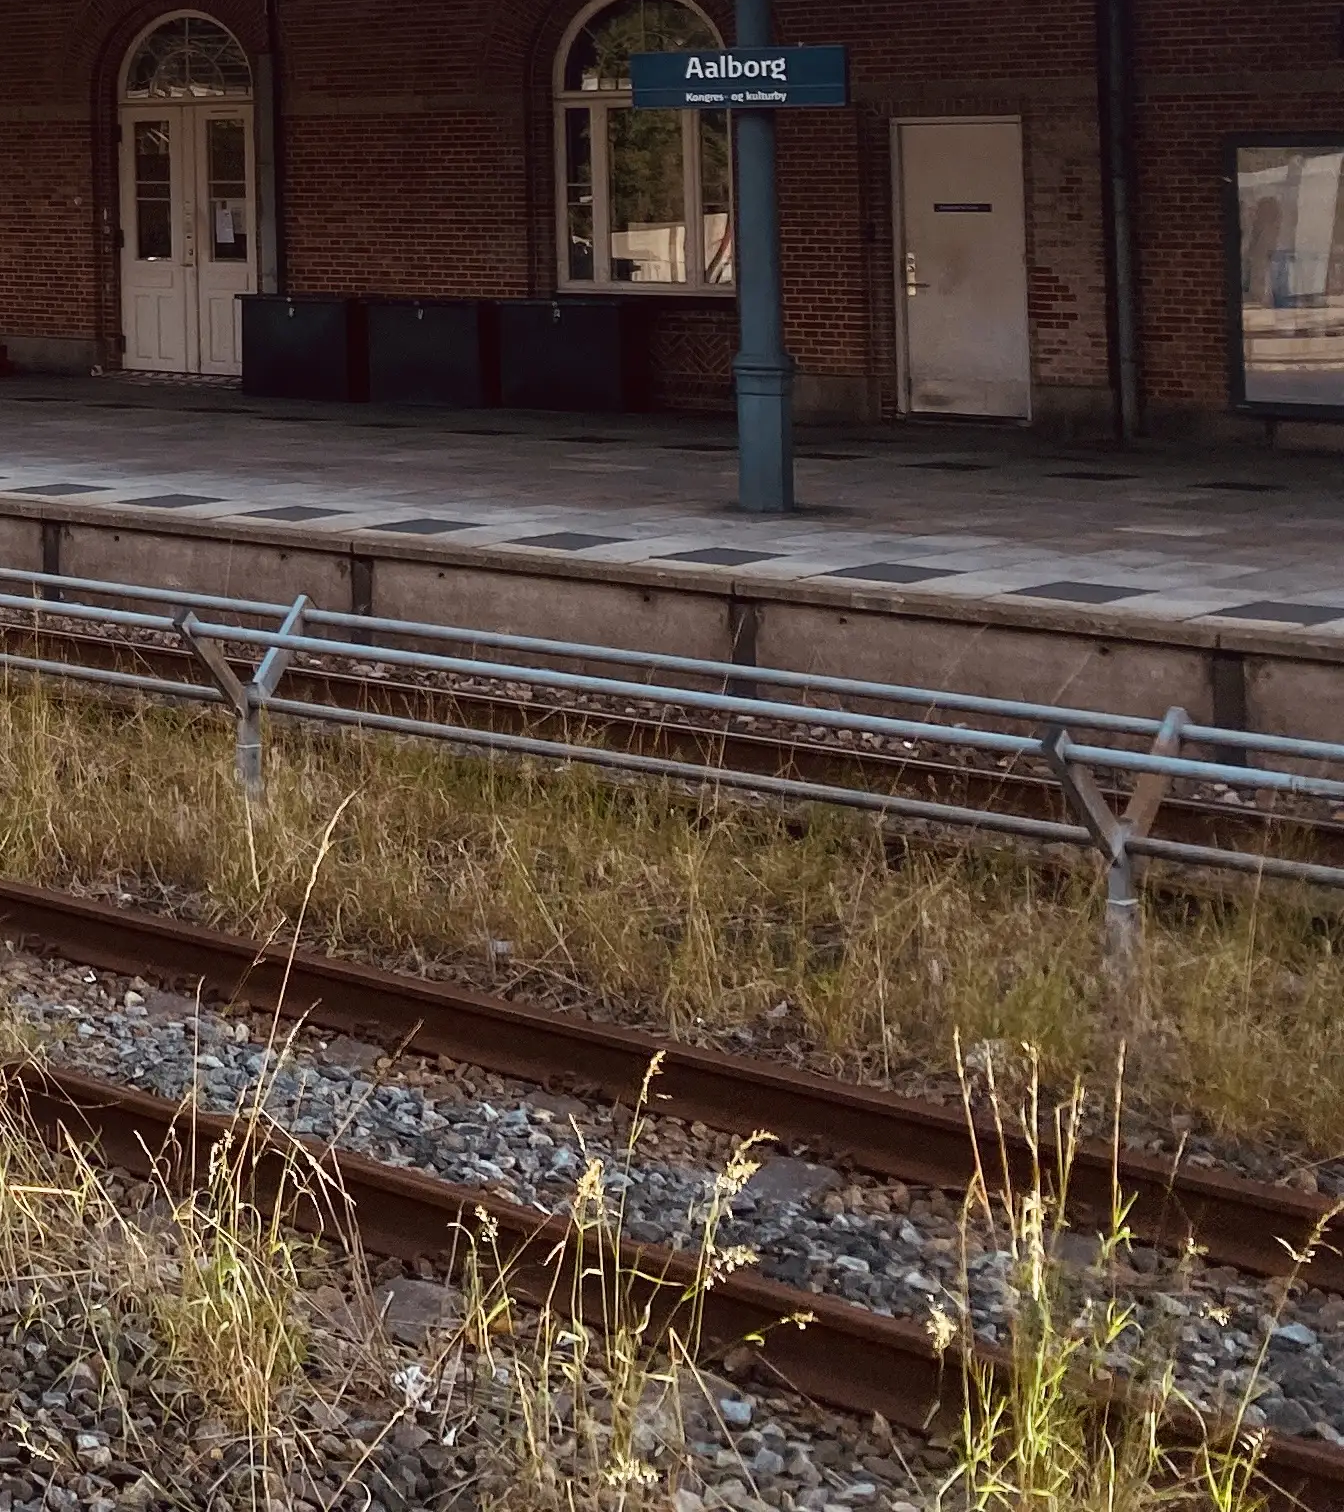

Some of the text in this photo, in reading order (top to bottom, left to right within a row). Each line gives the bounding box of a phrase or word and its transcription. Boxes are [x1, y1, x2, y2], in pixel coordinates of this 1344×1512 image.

[685, 55, 787, 81] Aalborg
[685, 91, 787, 103] Kongres- og kulturby
